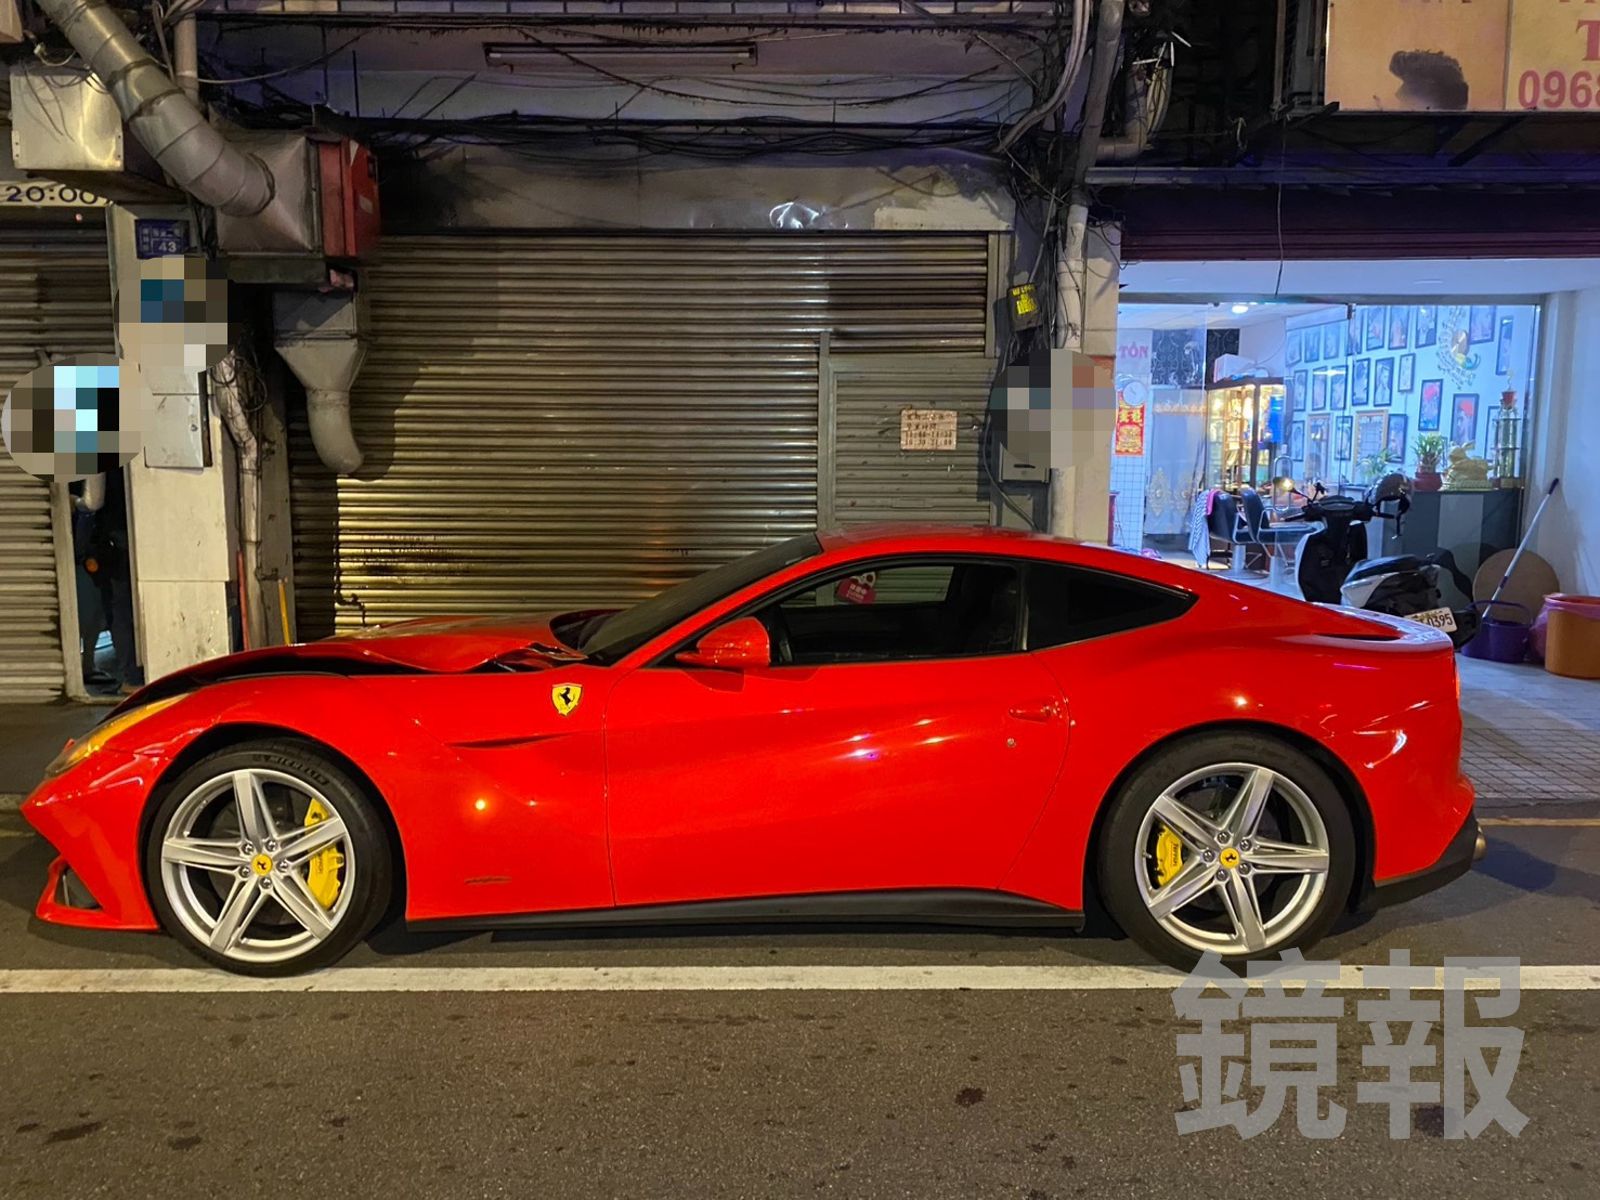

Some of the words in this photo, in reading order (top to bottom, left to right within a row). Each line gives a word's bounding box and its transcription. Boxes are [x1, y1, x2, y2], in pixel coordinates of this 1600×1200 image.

[1518, 70, 1600, 109] 096
[6, 186, 97, 205] 20:00
[159, 241, 177, 253] 43
[1120, 341, 1149, 358] TÔN
